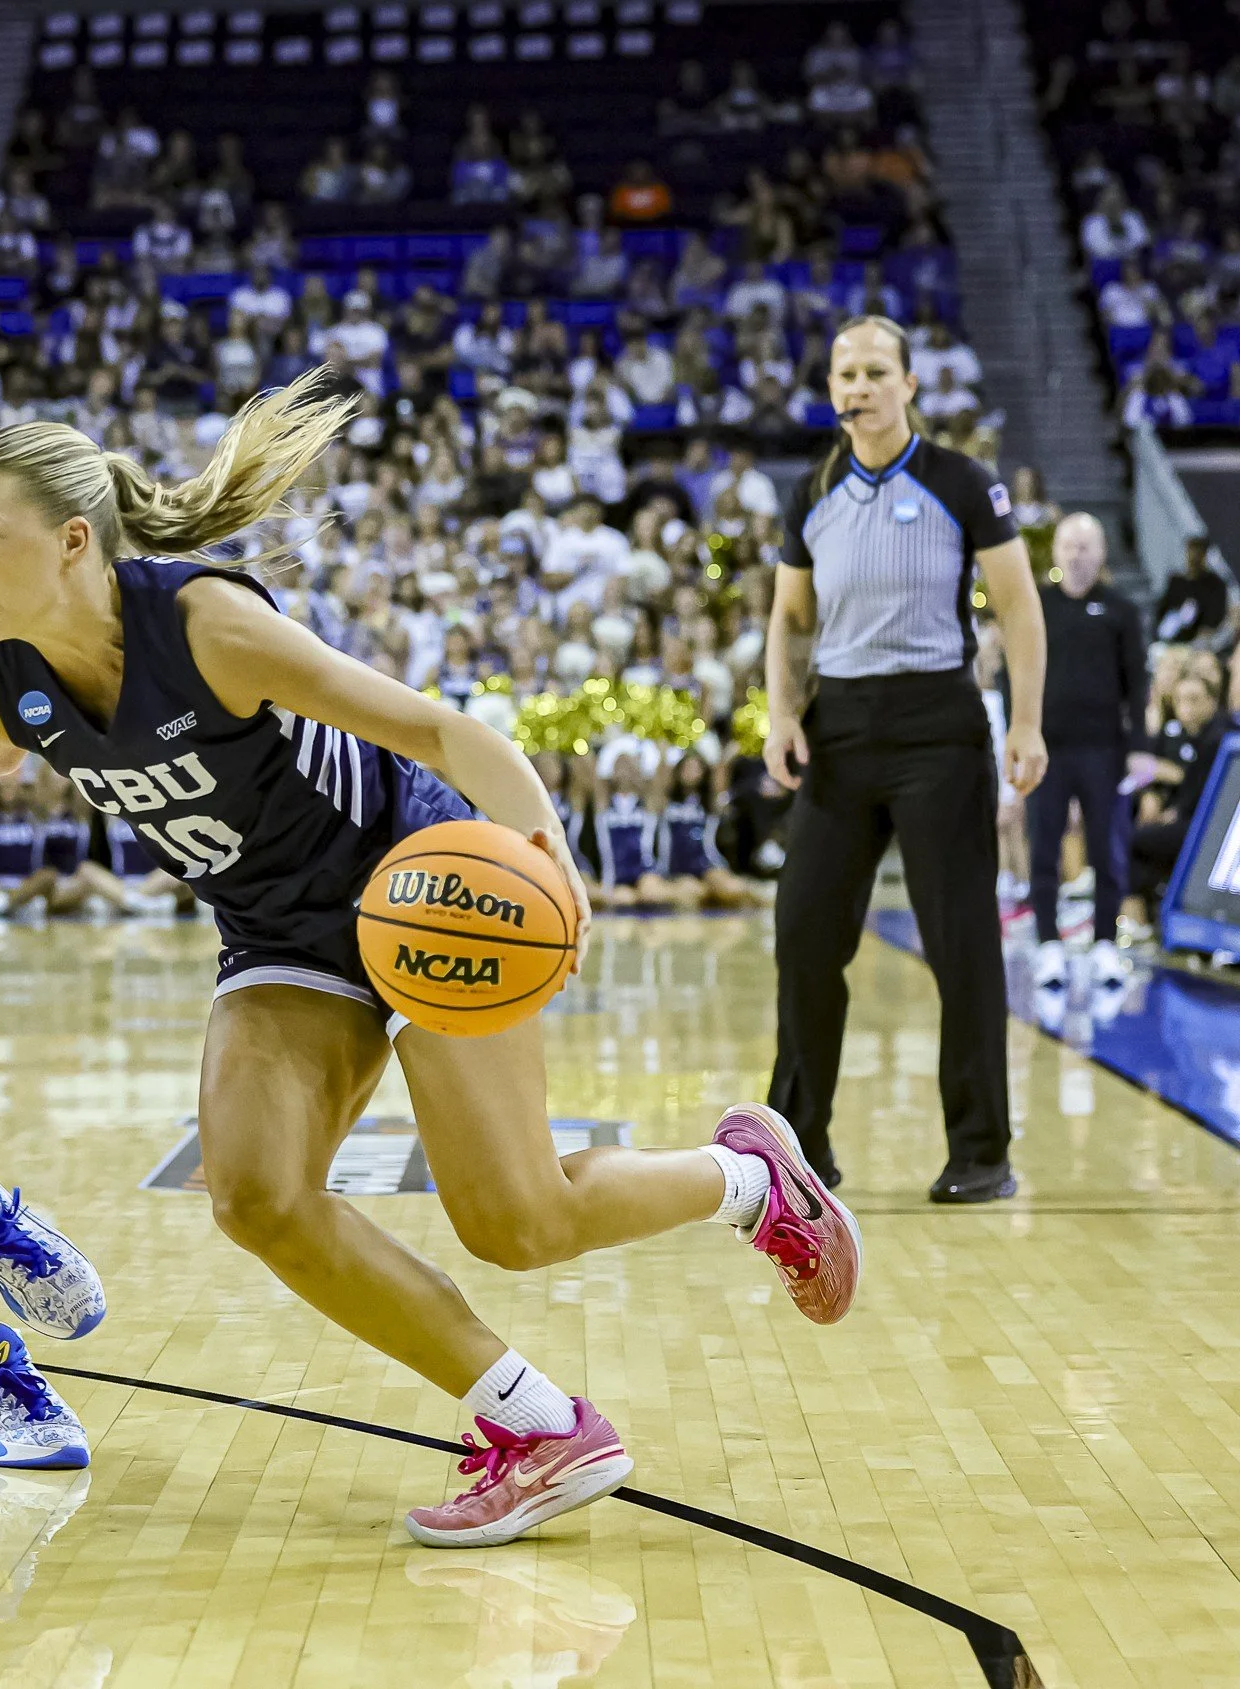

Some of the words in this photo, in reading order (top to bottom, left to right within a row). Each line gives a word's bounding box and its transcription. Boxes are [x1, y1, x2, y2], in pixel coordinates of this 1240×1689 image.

[23, 703, 52, 718] NCAA
[156, 710, 198, 741] WAC
[68, 751, 218, 815] CBU
[138, 814, 243, 879] 10
[387, 869, 526, 929] Wilson
[393, 943, 502, 987] NCAA
